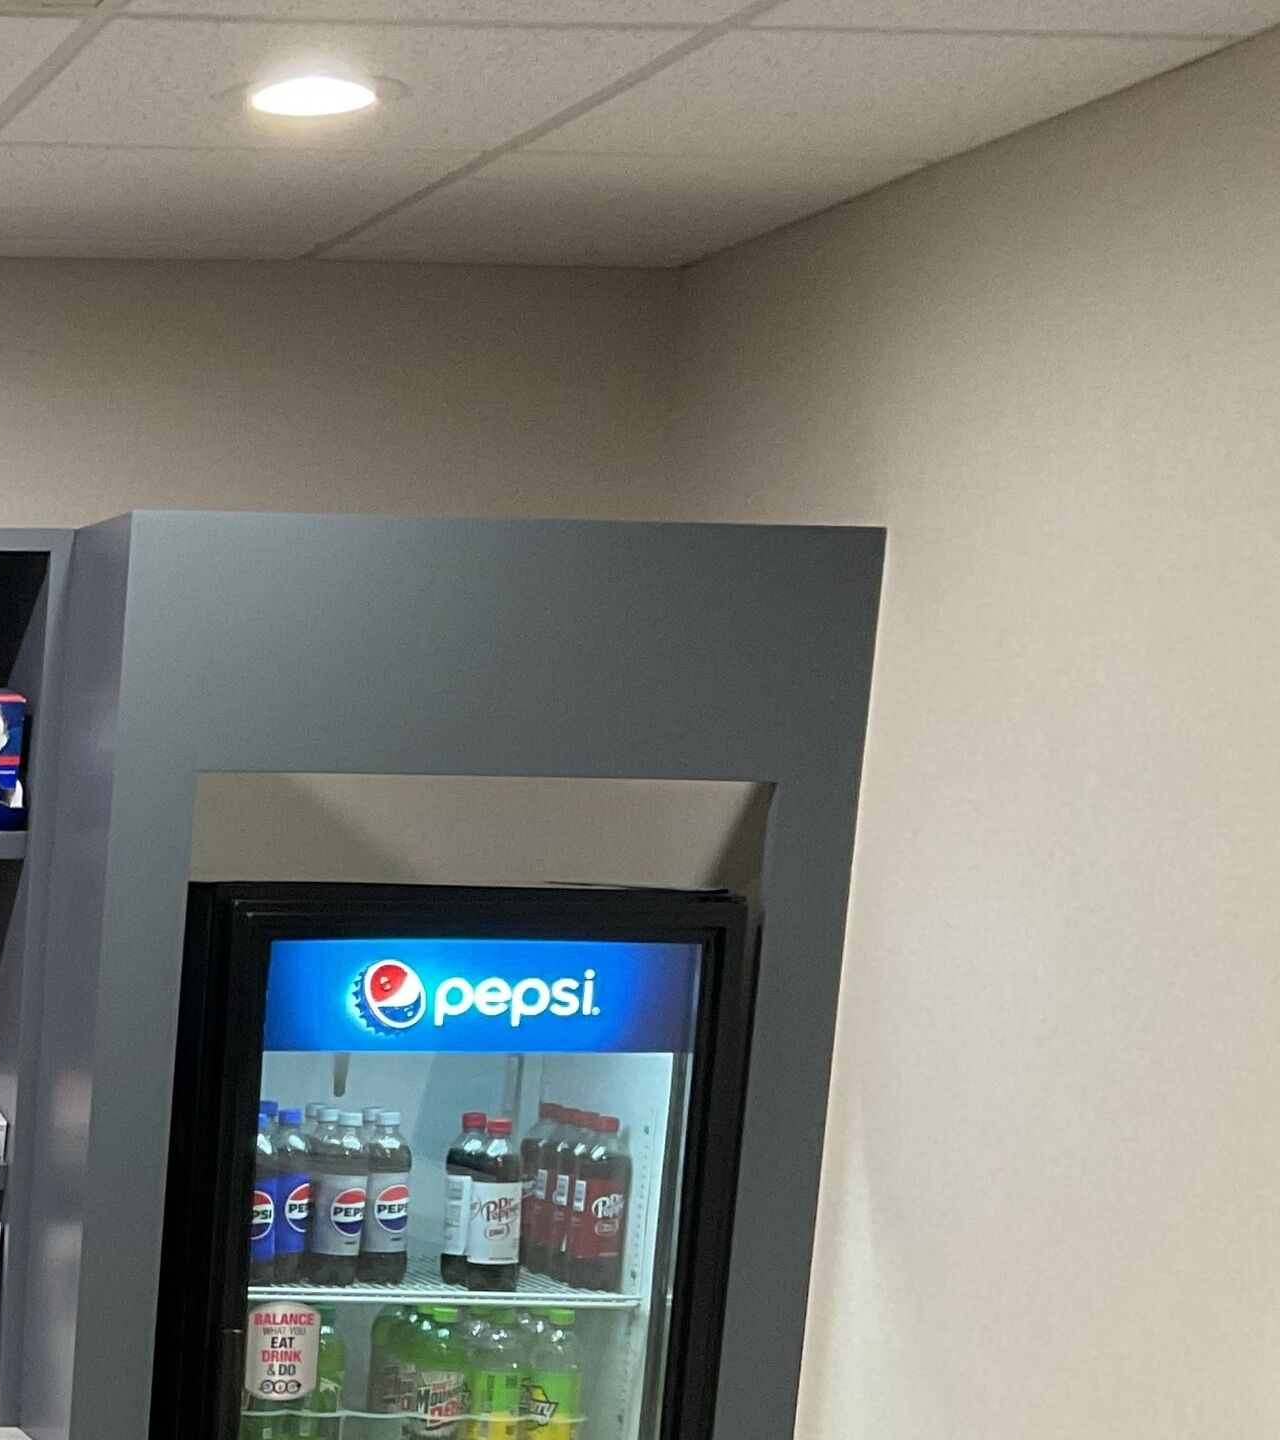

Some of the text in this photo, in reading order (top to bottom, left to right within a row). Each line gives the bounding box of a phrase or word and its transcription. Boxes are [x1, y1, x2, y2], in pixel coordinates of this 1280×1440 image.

[432, 968, 597, 1028] pepsi
[252, 1208, 272, 1220] PSI
[333, 1206, 365, 1218] PEPS
[377, 1203, 407, 1215] PEPS
[253, 1312, 315, 1326] BALANCE
[262, 1327, 307, 1335] WHAT YOU
[270, 1336, 295, 1349] EAT
[261, 1350, 302, 1363] DRINK
[278, 1363, 297, 1376] DO
